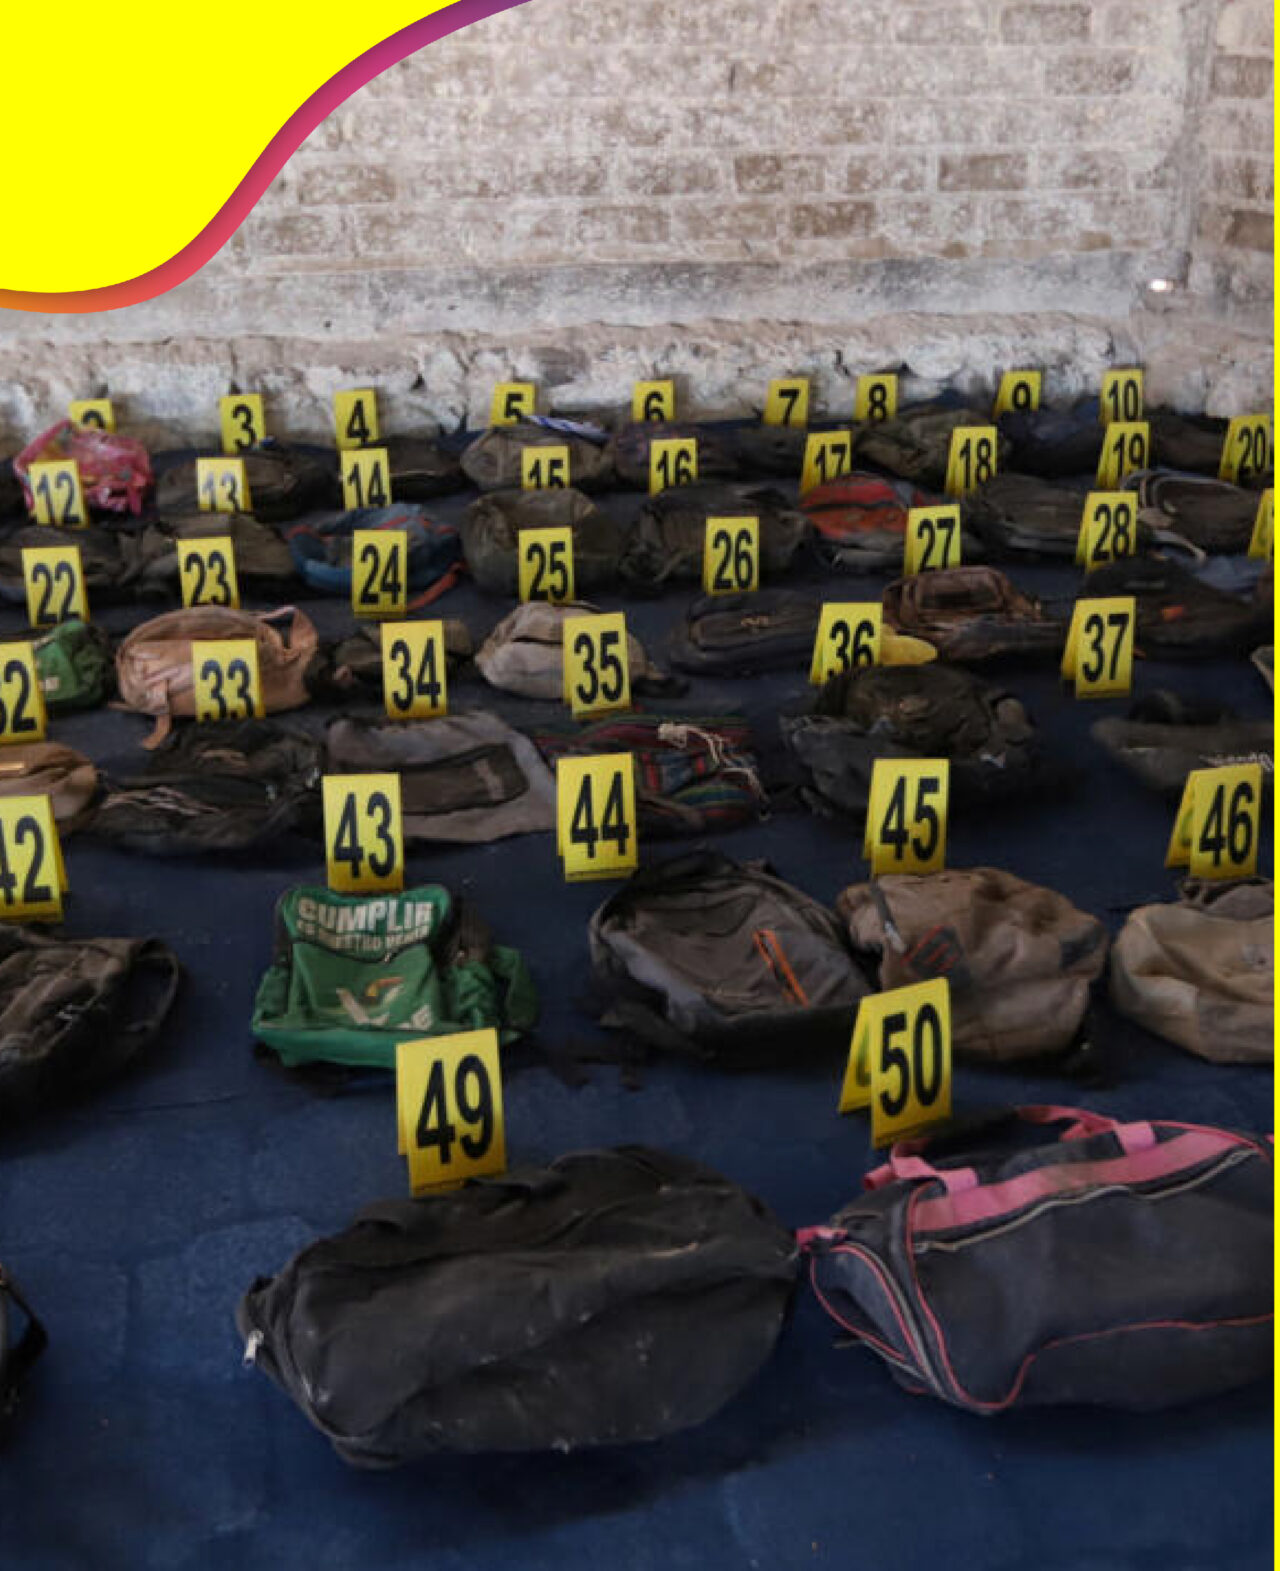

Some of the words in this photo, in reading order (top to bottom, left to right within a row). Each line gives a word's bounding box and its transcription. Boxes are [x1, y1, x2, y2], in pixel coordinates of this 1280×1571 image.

[232, 404, 258, 450] 3
[346, 400, 370, 446] 4
[504, 392, 523, 423] 5
[644, 391, 664, 422] 6
[779, 388, 801, 427] 7
[868, 383, 887, 421] 8
[1108, 380, 1139, 422] 10
[529, 458, 566, 488] 15
[657, 449, 692, 487] 16
[815, 443, 848, 484] 17
[959, 437, 992, 489] 18
[1113, 432, 1146, 487] 19
[1237, 425, 1267, 482] 20
[36, 471, 80, 524] 12
[202, 472, 239, 511] 13
[347, 461, 386, 509] 14
[712, 529, 754, 591] 26
[917, 518, 956, 572] 27
[1092, 503, 1132, 563] 28
[32, 561, 79, 625] 22
[184, 550, 231, 607] 23
[360, 543, 401, 605] 24
[527, 541, 569, 600] 25
[391, 636, 442, 711] 34
[573, 631, 625, 705] 35
[829, 620, 876, 674] 36
[1082, 613, 1130, 682] 37
[0, 660, 37, 734] 2
[201, 659, 256, 718] 33
[333, 791, 397, 879] 43
[571, 771, 630, 858] 44
[880, 775, 941, 862] 45
[1199, 781, 1255, 867] 46
[879, 1003, 943, 1117] 50
[416, 1054, 495, 1165] 49
